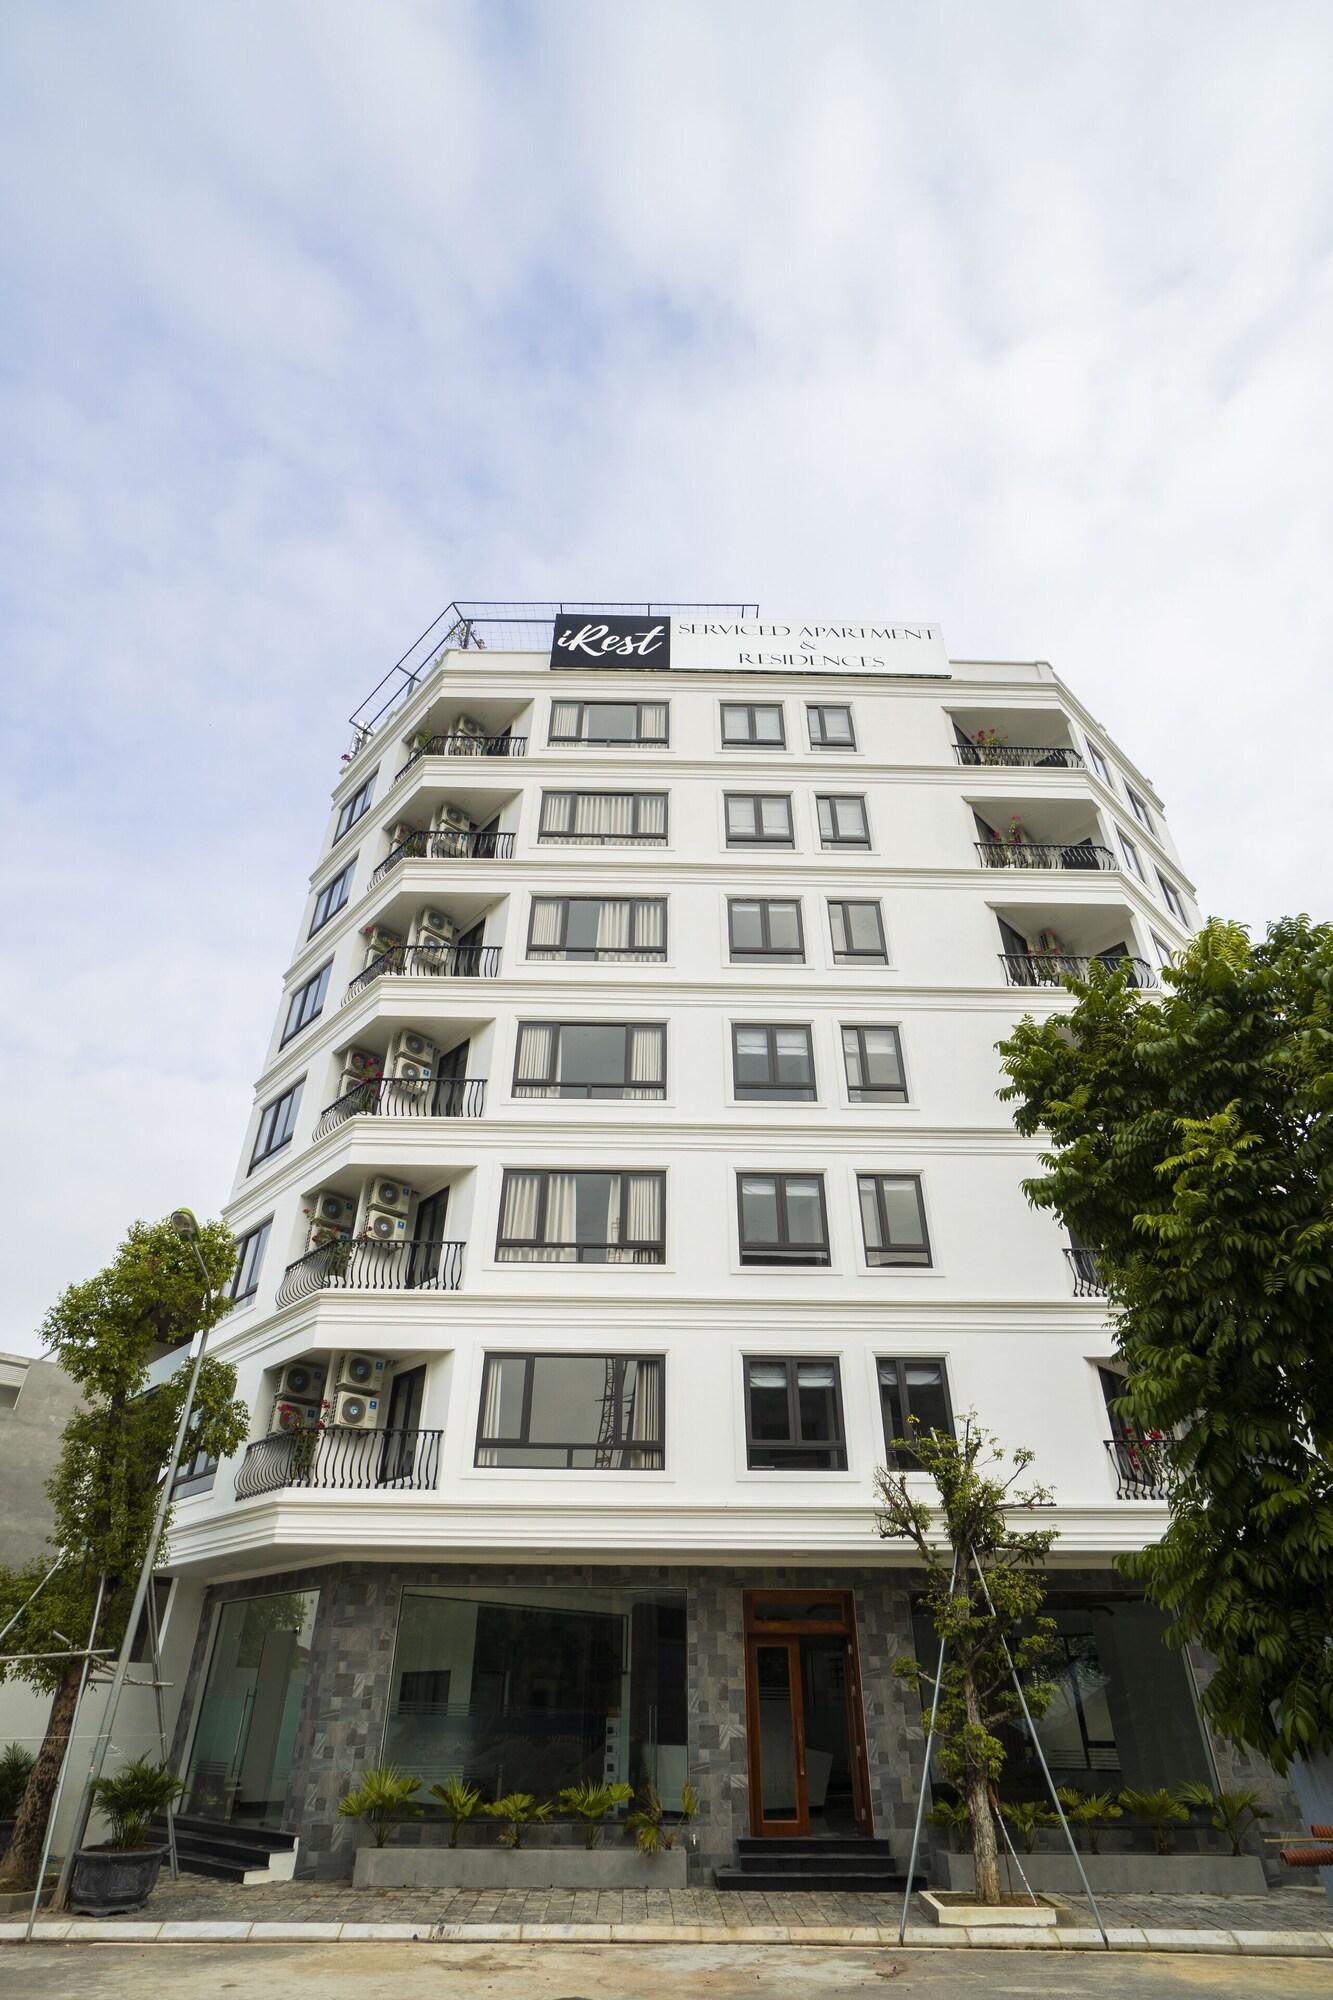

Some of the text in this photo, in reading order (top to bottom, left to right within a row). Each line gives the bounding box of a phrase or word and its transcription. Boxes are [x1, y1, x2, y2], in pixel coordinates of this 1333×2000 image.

[678, 623, 936, 640] SERVICED APARTMENT
[557, 624, 665, 657] iRest
[799, 640, 817, 651] &
[739, 652, 885, 668] RESIDENCES
